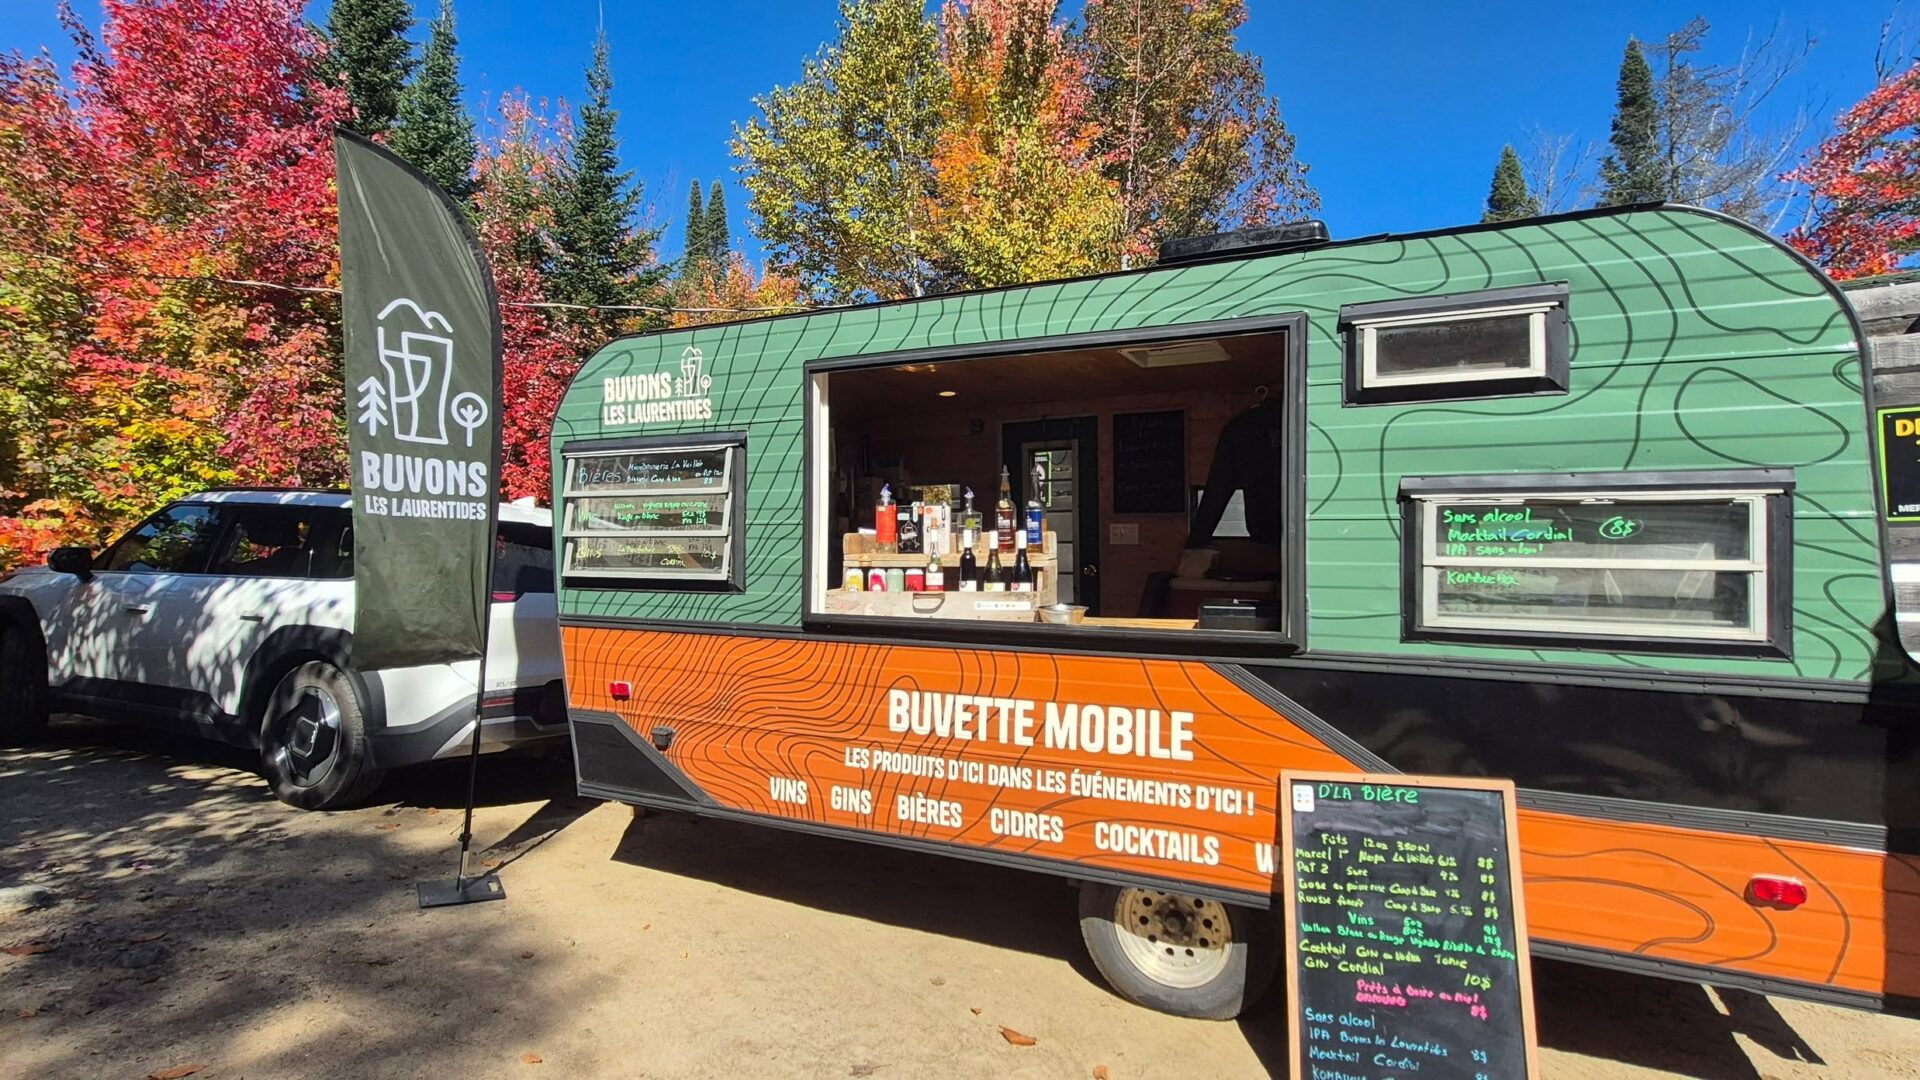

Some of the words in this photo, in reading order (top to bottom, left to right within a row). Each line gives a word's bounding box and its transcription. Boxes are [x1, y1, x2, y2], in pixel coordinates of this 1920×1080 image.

[604, 372, 672, 403] BUVONS
[604, 404, 626, 426] LES
[627, 398, 713, 424] LAURENTIDES
[361, 451, 487, 498] BUVONS
[579, 467, 621, 485] Bières
[365, 495, 388, 517] LES
[391, 498, 487, 521] LAURENTIDES
[1443, 509, 1478, 524] Sans
[1482, 507, 1532, 523] alcool
[1447, 528, 1508, 542] Mocktail
[1510, 527, 1574, 542] Cordial
[1610, 520, 1636, 538] 8$
[888, 689, 1036, 747] BUVETTE
[1044, 701, 1196, 762] MOBILE
[844, 747, 870, 769] LES
[872, 751, 945, 780] PRODUITS
[947, 759, 984, 785] D'ICI
[986, 764, 1033, 791] DANS
[1036, 768, 1067, 796] LES
[1070, 768, 1192, 810] ÉVÉNEMENTS
[1195, 786, 1245, 816] D'ICI
[1246, 792, 1256, 817] !
[1318, 784, 1352, 801] D'LA
[1361, 785, 1418, 803] Bière
[769, 777, 808, 805] VINS
[830, 785, 872, 815] GINS
[896, 791, 963, 829] BIÈRES
[990, 807, 1065, 844] CIDRES
[1094, 821, 1219, 867] COCKTAILS
[1319, 863, 1329, 874] 2
[1347, 911, 1374, 925] Vins
[1299, 938, 1346, 956] Cocktail
[1355, 946, 1379, 958] GIN
[1304, 956, 1330, 969] GIN
[1337, 961, 1385, 976] Cordial
[1463, 973, 1491, 991] 10$
[1304, 1007, 1334, 1024] Sans
[1338, 1012, 1376, 1030] alcool
[1309, 1027, 1330, 1041] IPA
[1308, 1044, 1360, 1064] Mocktail
[1372, 1052, 1420, 1071] Cordial
